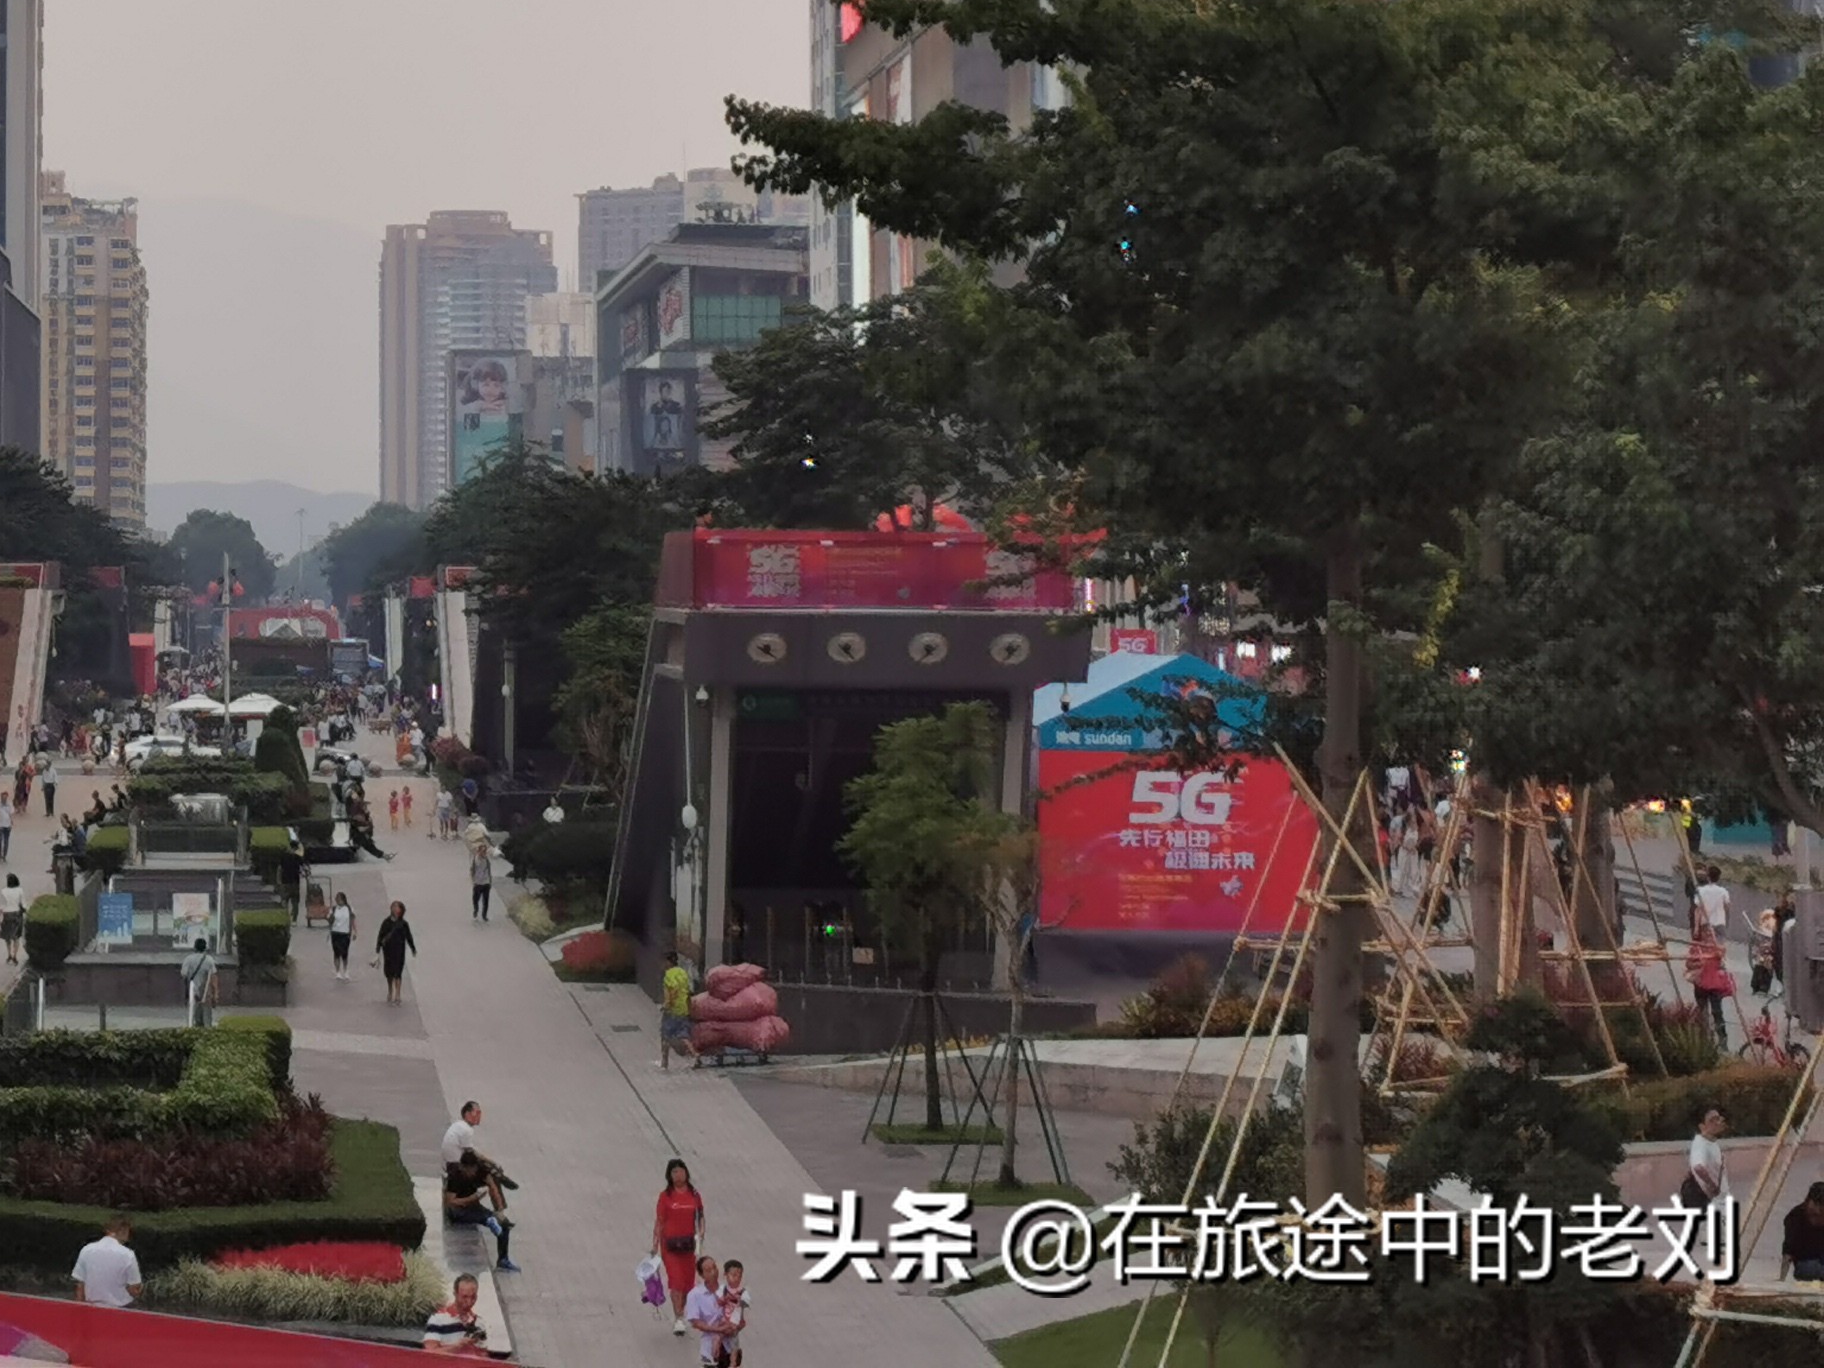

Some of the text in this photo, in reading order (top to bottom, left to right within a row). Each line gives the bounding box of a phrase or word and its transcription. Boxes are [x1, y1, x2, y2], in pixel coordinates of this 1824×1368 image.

[1084, 731, 1132, 746] sundan
[1128, 770, 1233, 825] 5G
[1119, 829, 1210, 848] 先行福田
